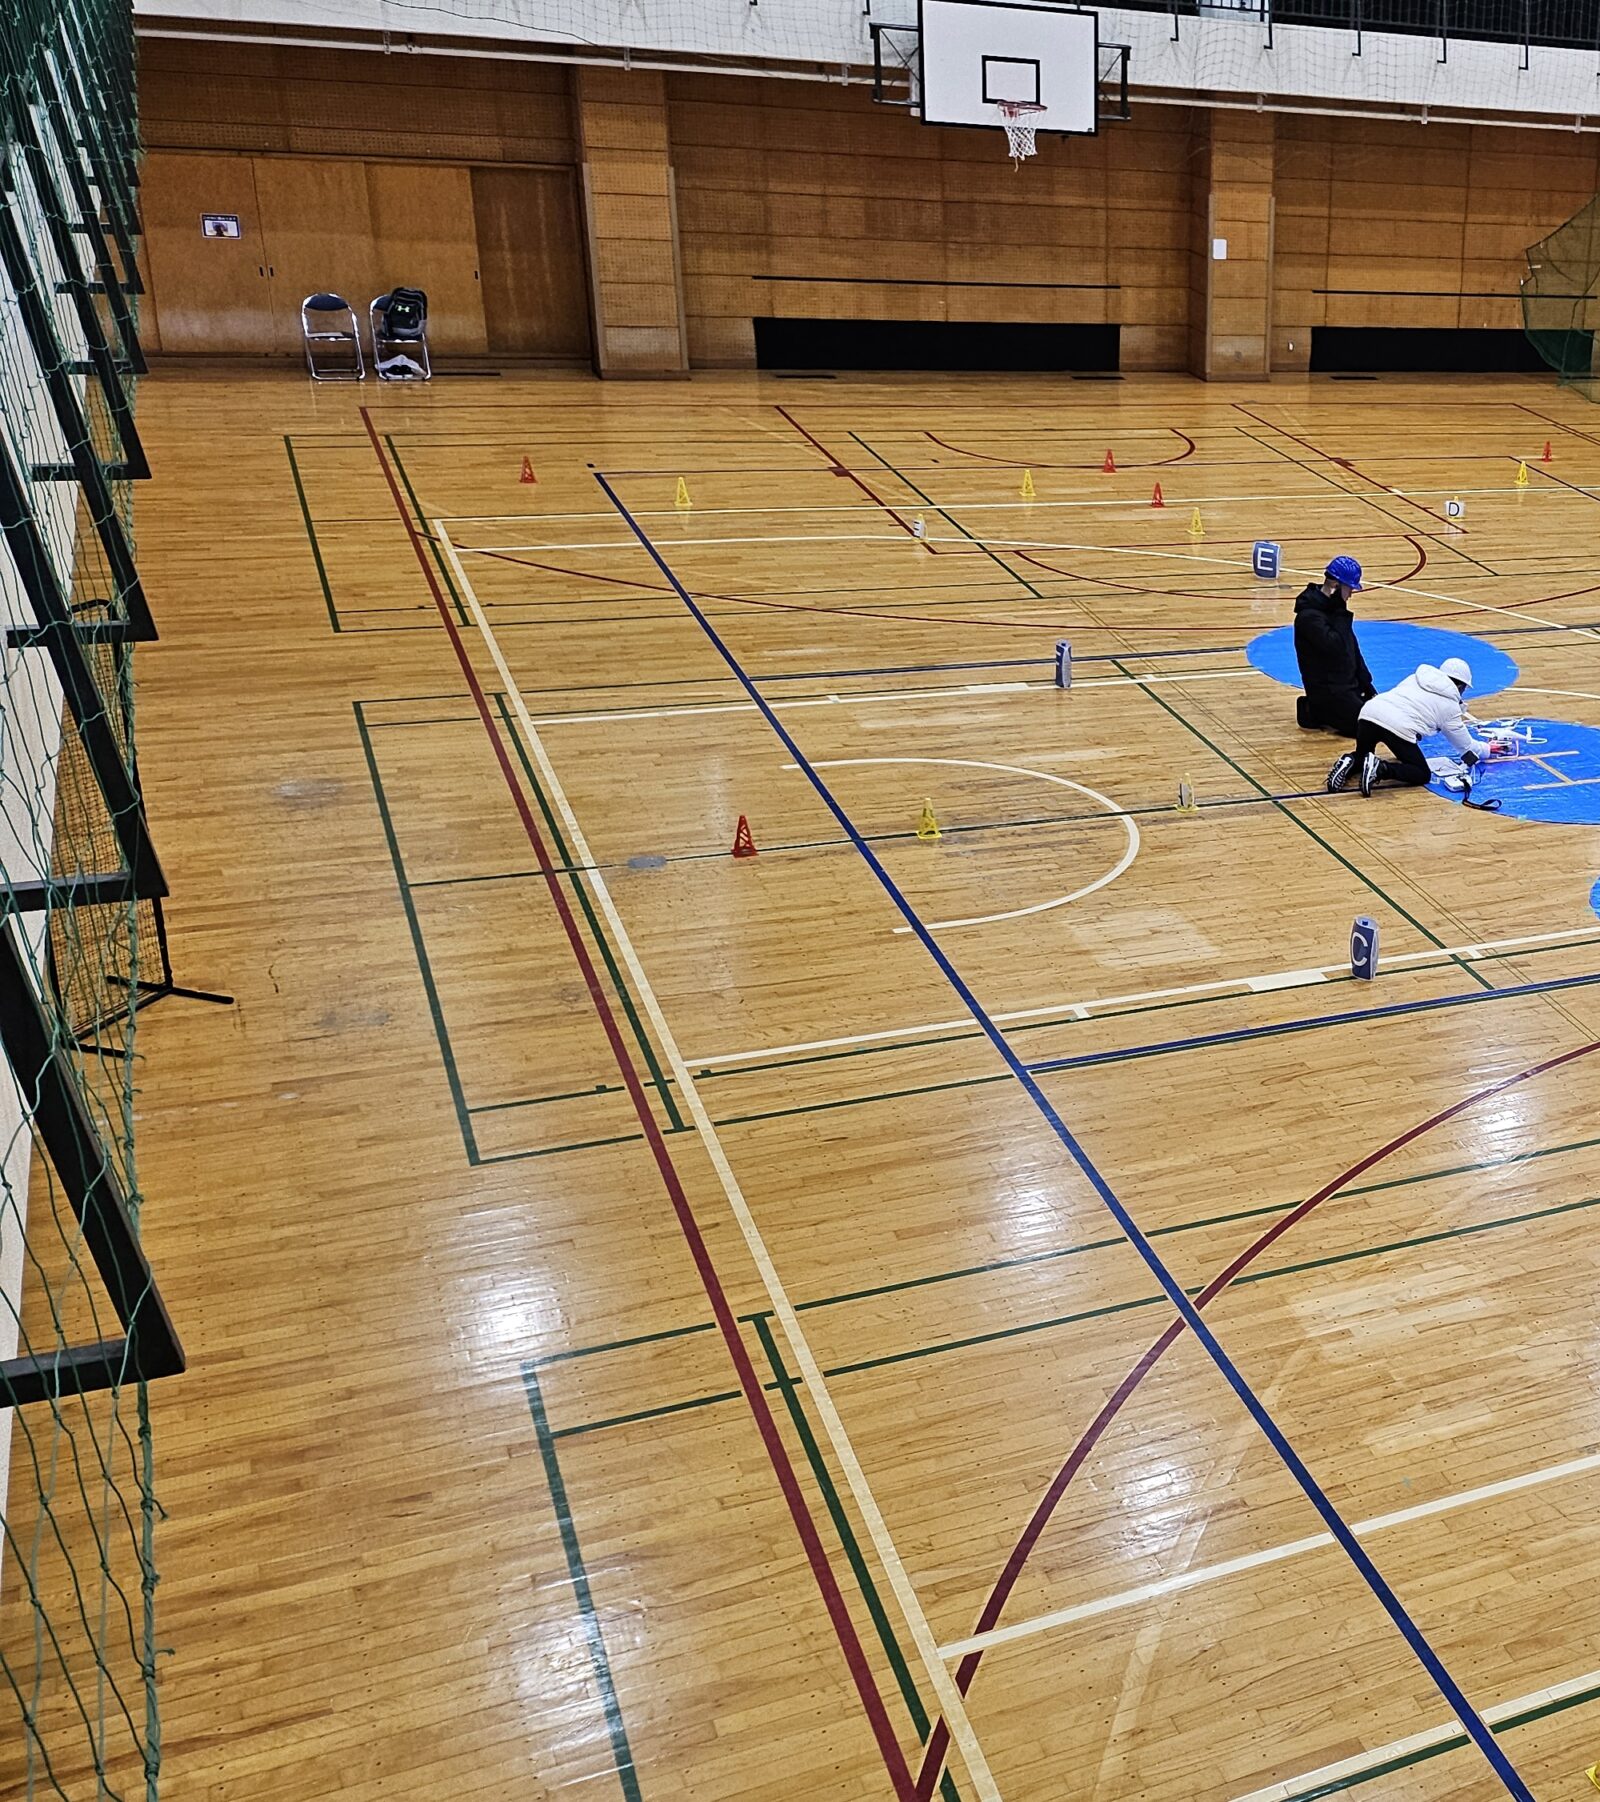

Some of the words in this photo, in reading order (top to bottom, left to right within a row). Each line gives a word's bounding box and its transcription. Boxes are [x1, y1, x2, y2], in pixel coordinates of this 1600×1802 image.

[1448, 502, 1460, 517] D
[1257, 547, 1275, 571] E
[1351, 931, 1369, 967] C
